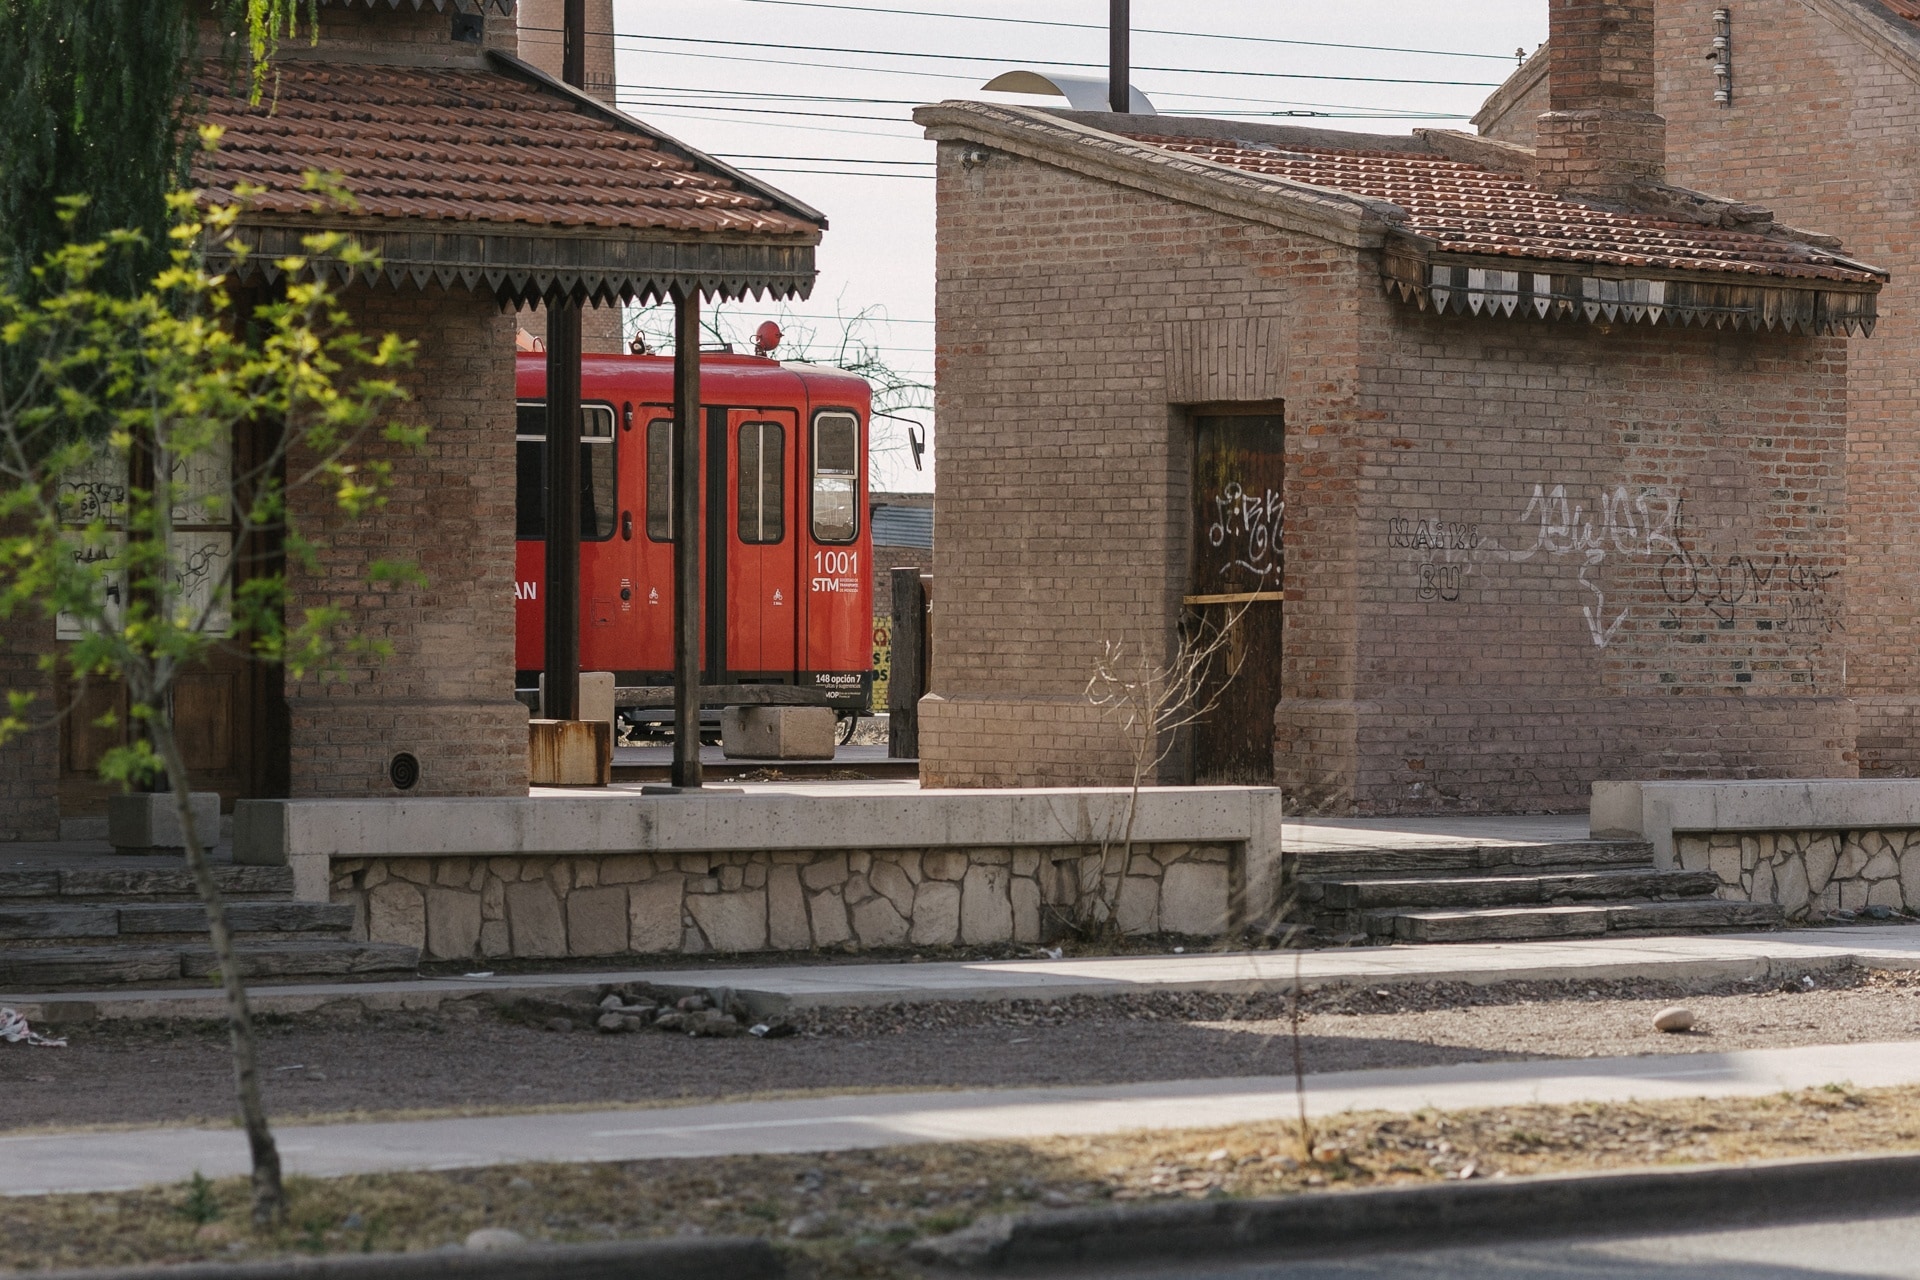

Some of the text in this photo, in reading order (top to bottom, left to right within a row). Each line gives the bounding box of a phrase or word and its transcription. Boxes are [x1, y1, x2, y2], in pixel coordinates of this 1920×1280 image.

[814, 550, 857, 575] 1001
[812, 577, 839, 592] STM
[815, 674, 862, 685] 148 opción 7
